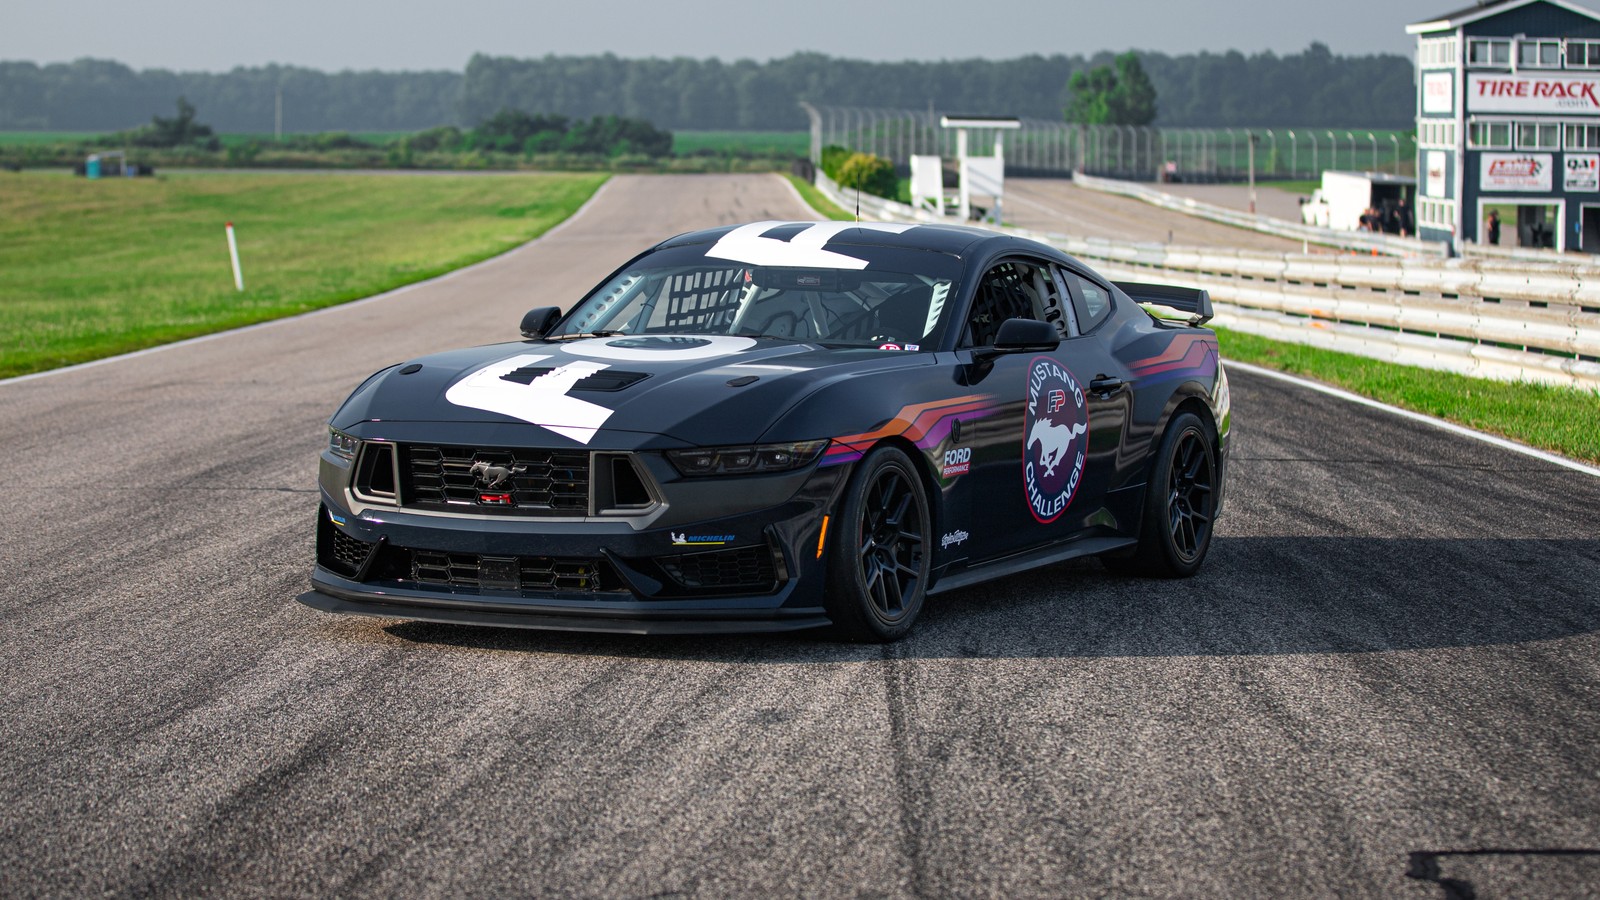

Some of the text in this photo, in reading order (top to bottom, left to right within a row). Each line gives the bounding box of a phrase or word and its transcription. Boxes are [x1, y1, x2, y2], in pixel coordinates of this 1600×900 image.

[1477, 80, 1600, 107] TIRE RACK
[1028, 362, 1084, 416] MUSTANG
[943, 464, 969, 475] PERFORMANCE
[944, 447, 971, 466] FORD
[1025, 450, 1084, 516] CHALLENGE
